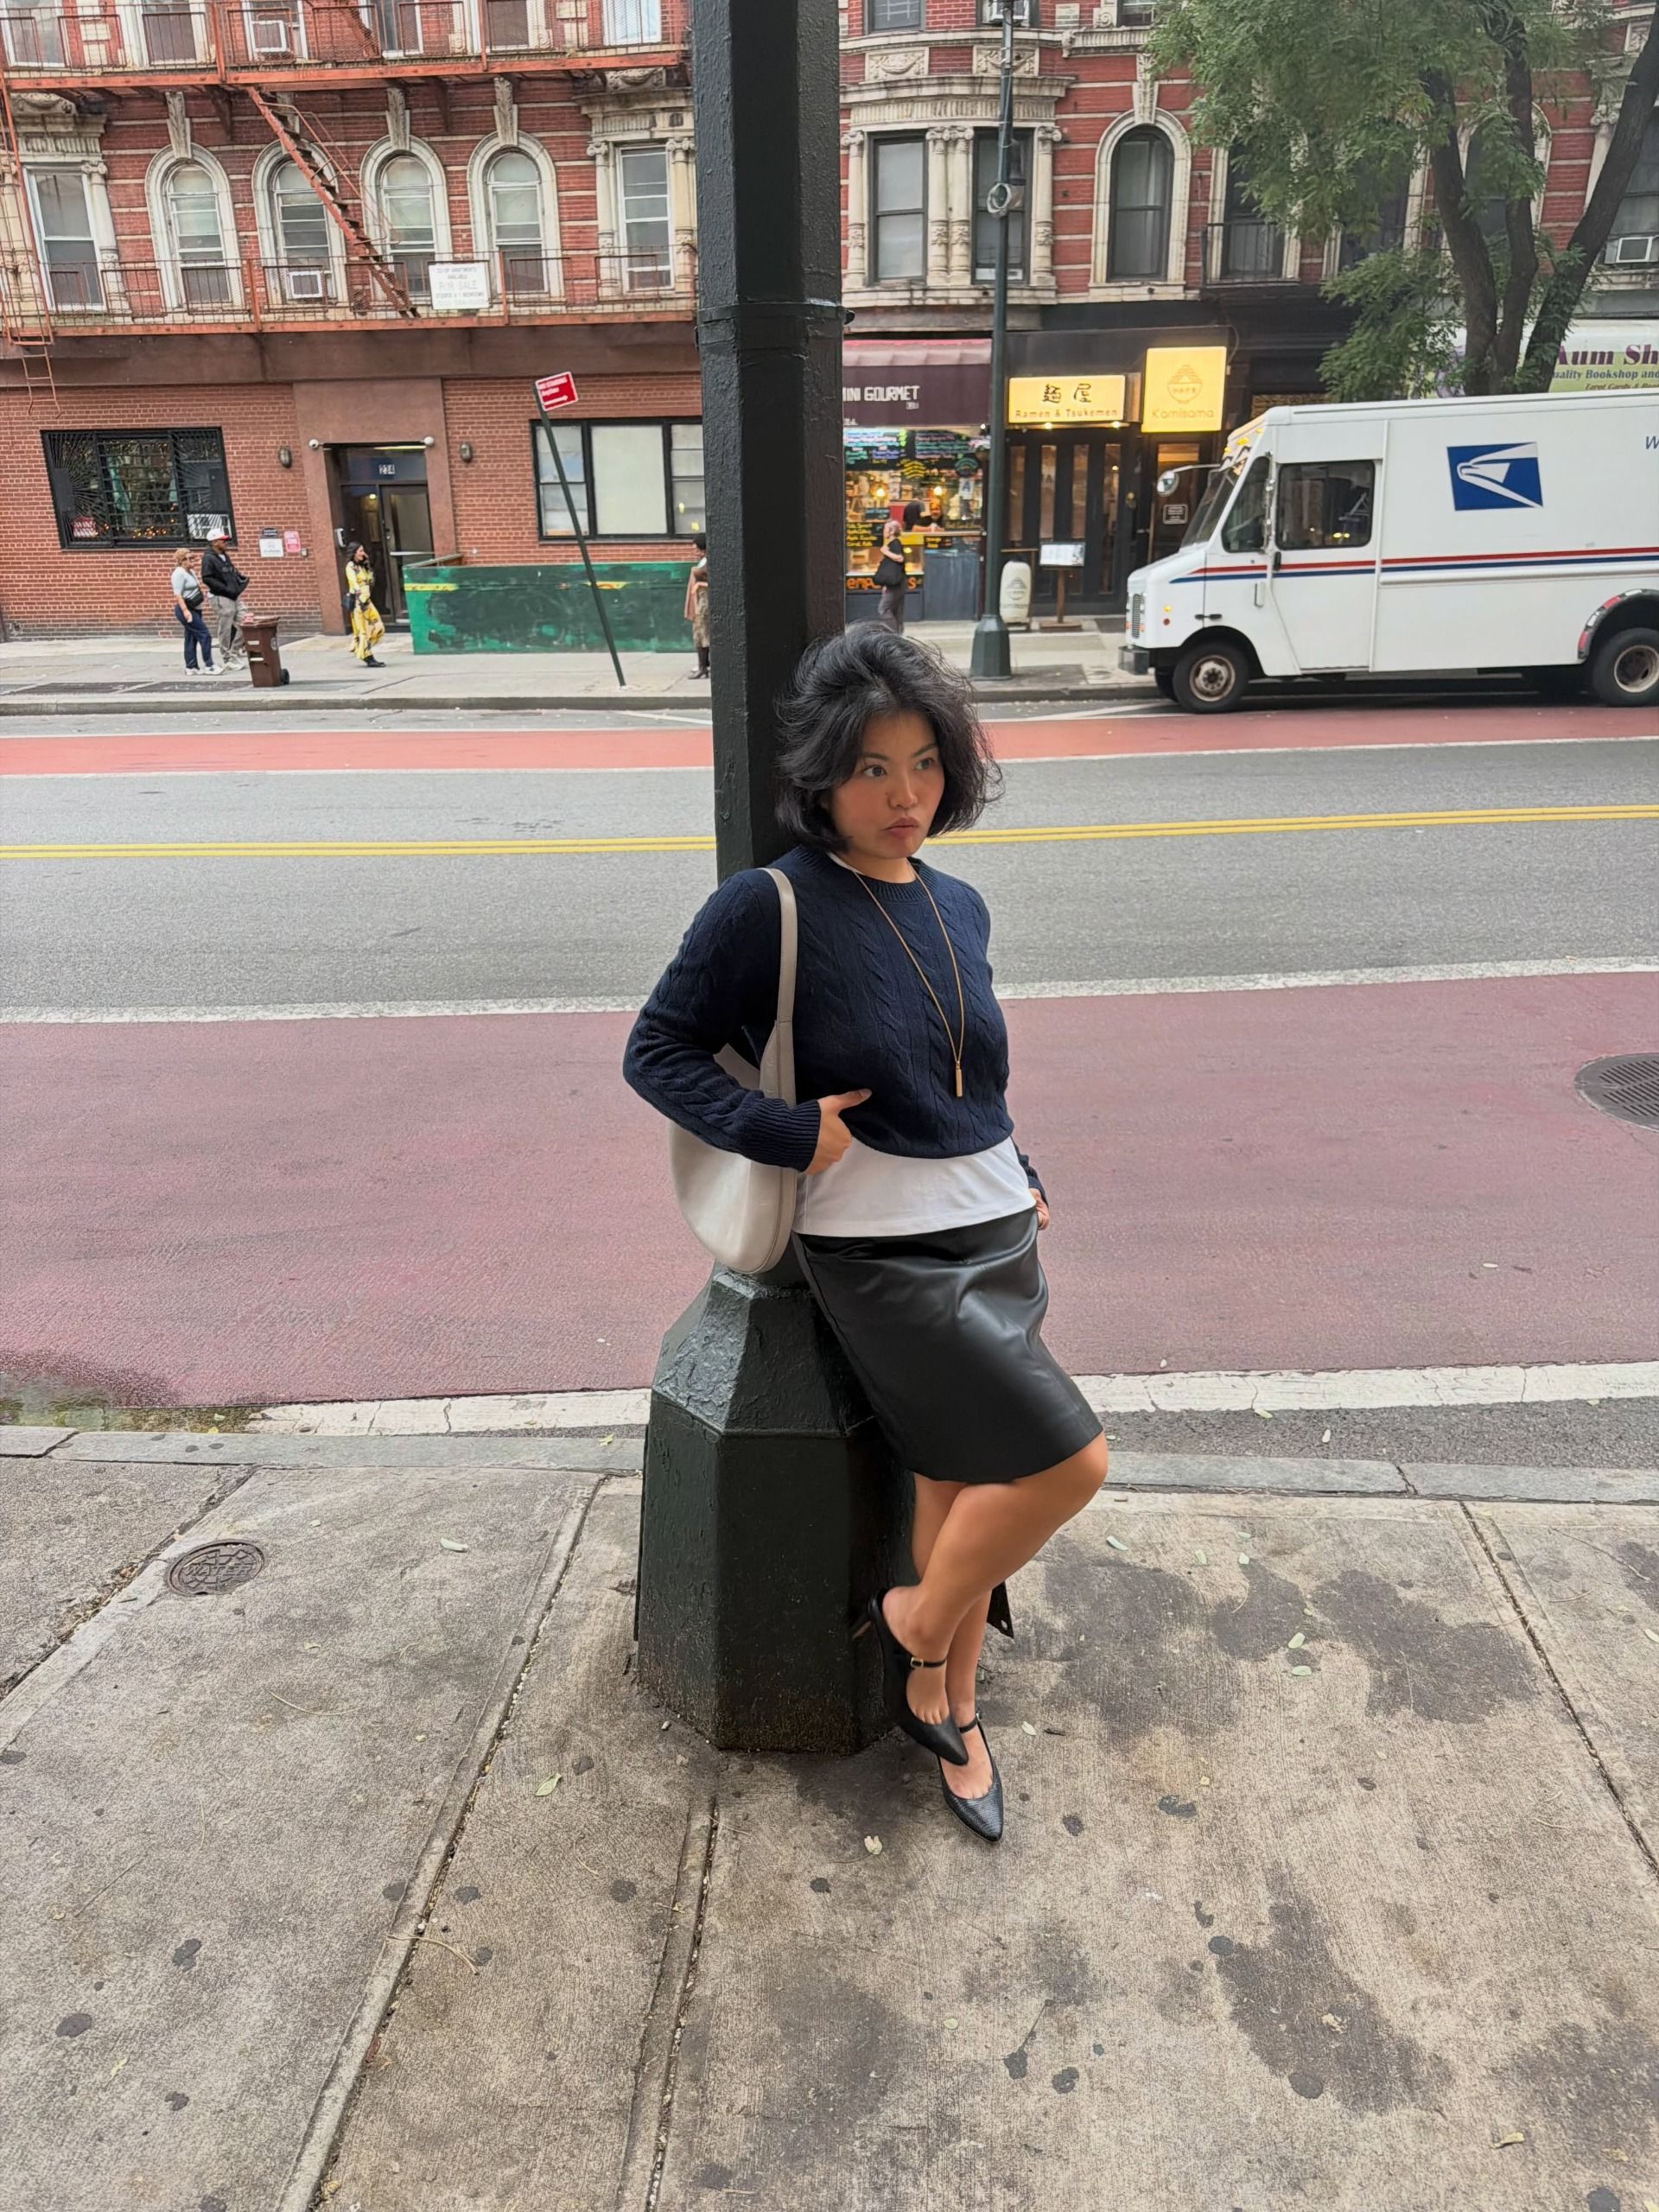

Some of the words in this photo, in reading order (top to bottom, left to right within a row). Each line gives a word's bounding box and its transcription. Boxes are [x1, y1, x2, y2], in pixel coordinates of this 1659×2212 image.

[1558, 346, 1613, 365] Aum
[1553, 369, 1582, 381] uality
[1586, 369, 1638, 380] Bookshop
[864, 385, 920, 401] GOURMET
[1015, 410, 1050, 419] Ramen
[1056, 409, 1061, 417] &
[1066, 408, 1117, 417] Tsukemen
[1152, 408, 1215, 419] Kamisama
[182, 1565, 252, 1577] WATER
